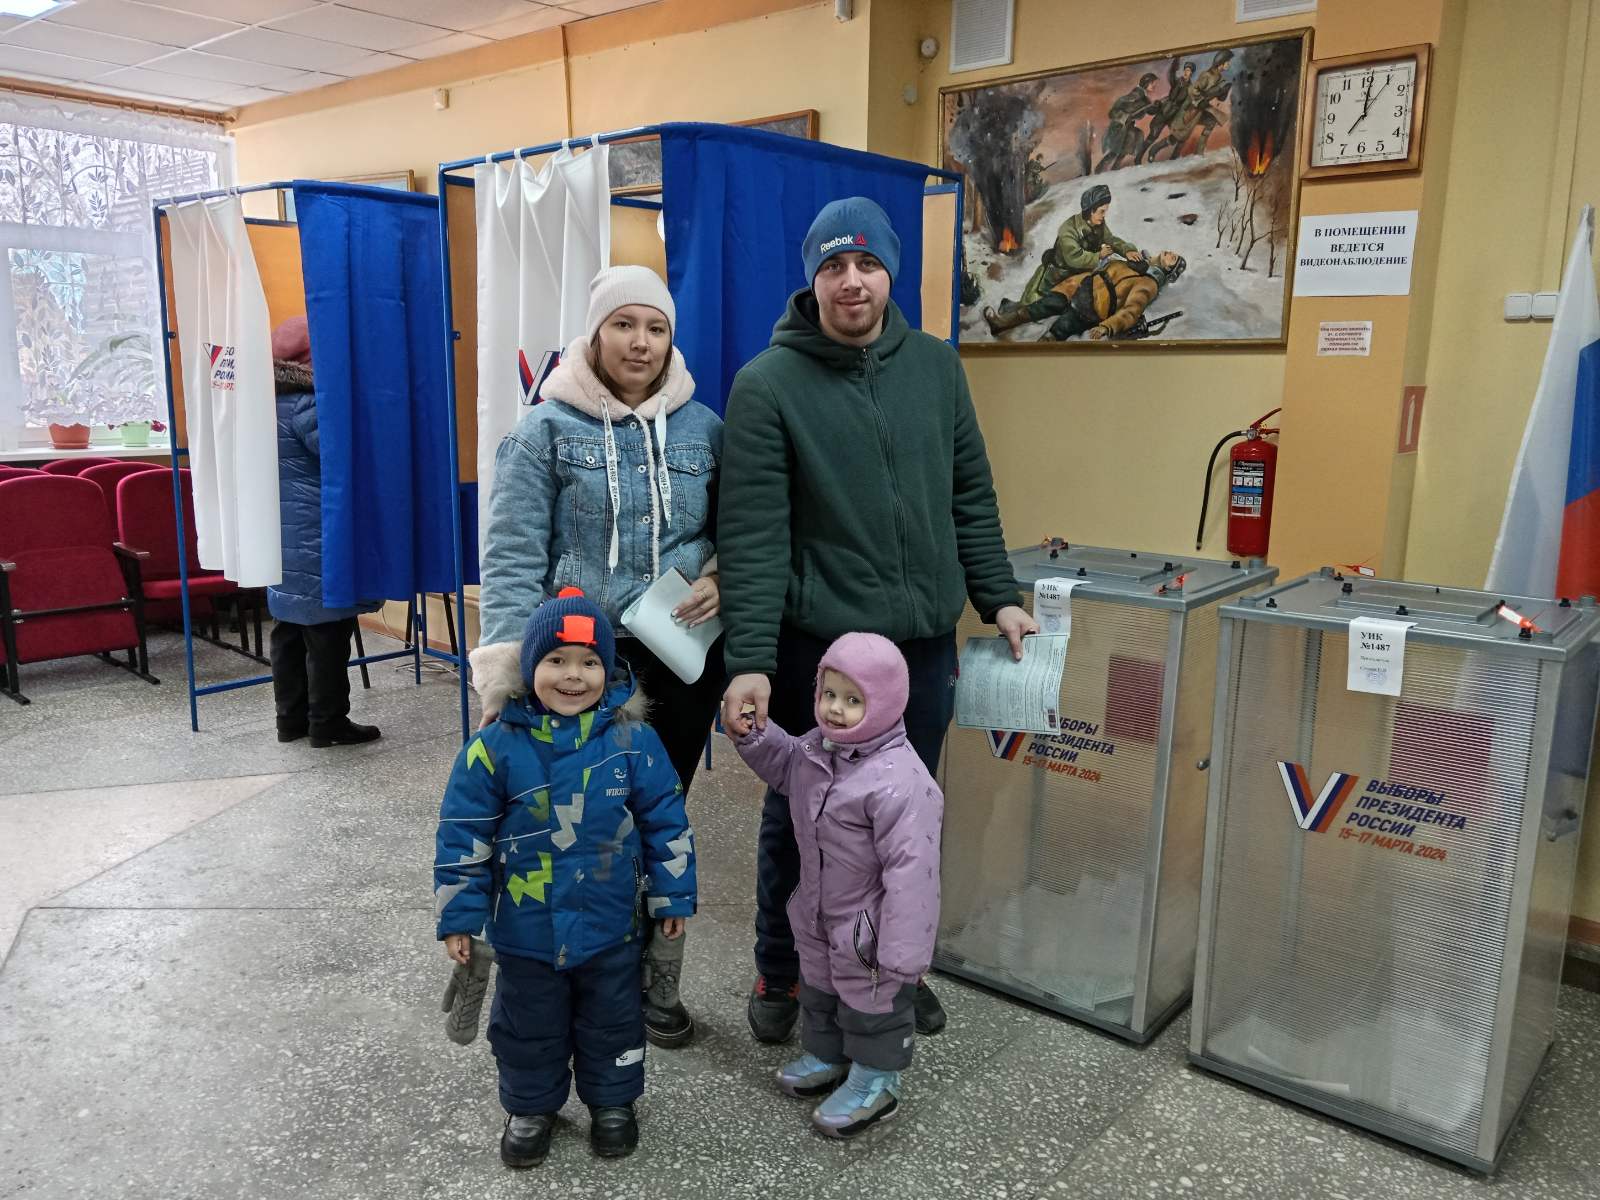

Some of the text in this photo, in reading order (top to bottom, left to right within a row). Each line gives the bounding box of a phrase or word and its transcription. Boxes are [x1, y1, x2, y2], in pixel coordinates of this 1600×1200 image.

[1342, 78, 1351, 90] 11
[1397, 84, 1406, 96] 2
[1330, 92, 1341, 104] 10
[1394, 106, 1403, 118] 3
[1328, 113, 1336, 124] 9
[1326, 132, 1334, 144] 8
[1392, 128, 1400, 138] 4
[1340, 144, 1348, 156] 7
[1357, 142, 1366, 154] 6
[1376, 140, 1385, 152] 5
[1314, 226, 1406, 237] В ПОМЕЩЕНИИ
[820, 234, 854, 254] Reebok
[1330, 242, 1385, 254] ВЕДЕТСЯ
[1300, 256, 1408, 268] ВИДЕОНАБЛЮДЕНИЕ
[1039, 592, 1060, 600] №1487
[1360, 632, 1384, 640] УИК
[1360, 642, 1391, 652] №1487
[1060, 717, 1099, 736] БОРЫ
[1028, 742, 1079, 763] РОССИИ
[1047, 762, 1078, 777] МАРТА
[1366, 779, 1446, 806] ВЫБОРЫ
[1356, 796, 1467, 830] ПРЕЗИДЕНТА
[1346, 812, 1416, 838] РОССИИ
[1373, 834, 1412, 855] МАРТА
[1414, 844, 1448, 862] 2024
